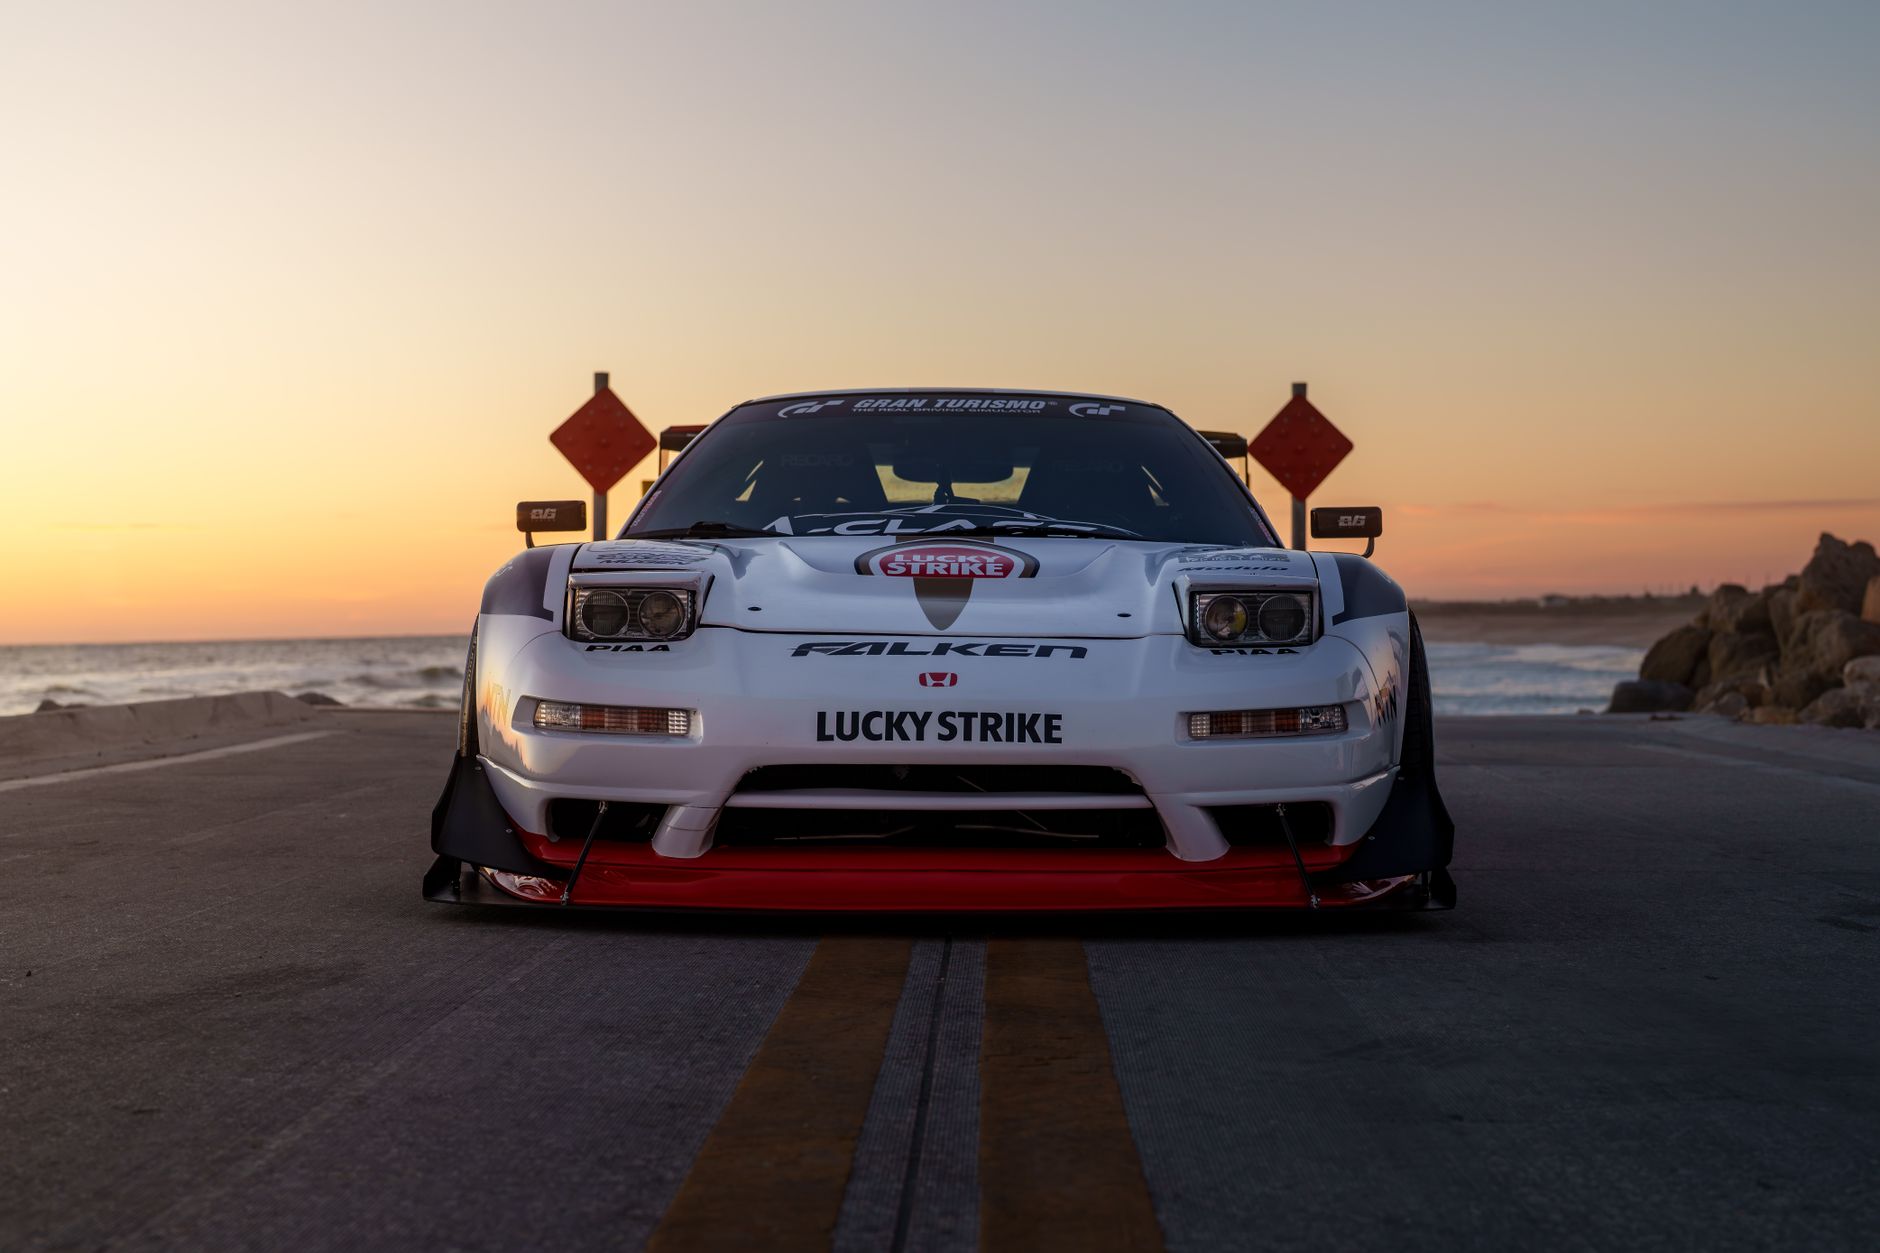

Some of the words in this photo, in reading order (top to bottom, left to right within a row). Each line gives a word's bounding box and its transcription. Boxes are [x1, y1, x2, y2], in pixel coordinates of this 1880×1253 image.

[853, 399, 929, 408] GRAN
[933, 399, 1046, 410] TURISMO
[894, 554, 1001, 563] LUCKY
[886, 562, 1004, 577] STRIKE
[790, 641, 1088, 659] FALKEN
[1209, 648, 1300, 656] PIAA
[816, 710, 934, 742] LUCKY
[936, 711, 1063, 744] STRIKE
